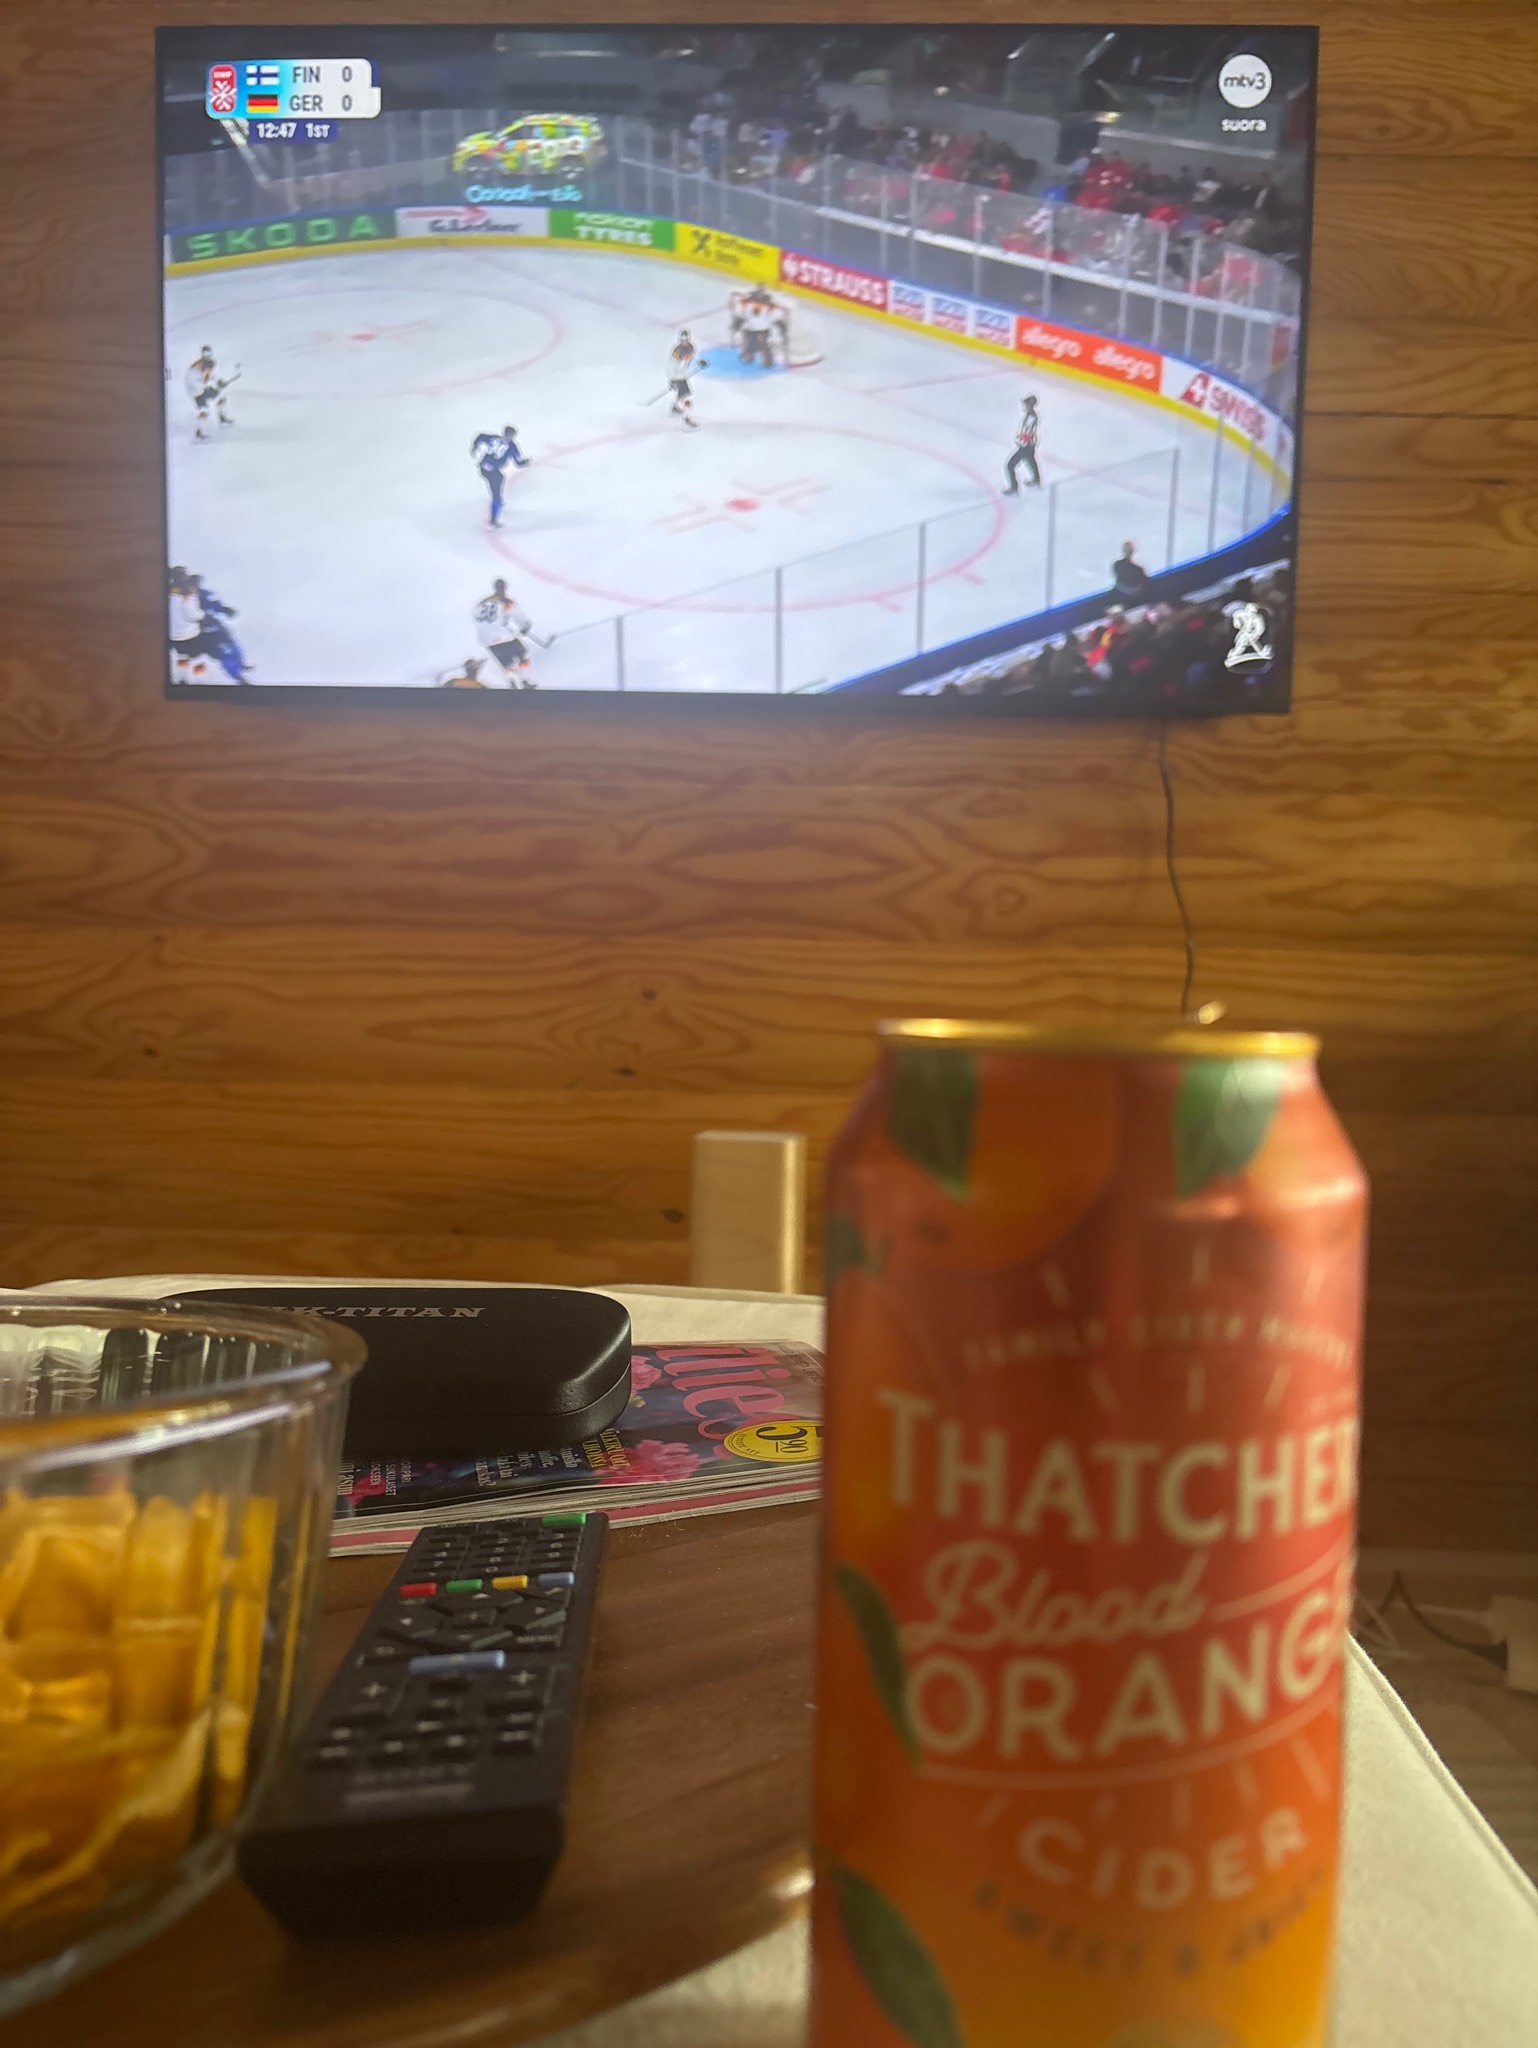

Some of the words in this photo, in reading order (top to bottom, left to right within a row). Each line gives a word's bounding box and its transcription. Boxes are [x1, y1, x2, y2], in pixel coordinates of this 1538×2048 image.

[292, 66, 321, 83] FIN
[342, 66, 353, 83] 0
[1223, 72, 1266, 90] mtv3
[289, 95, 323, 111] GER
[342, 95, 353, 111] 0
[256, 123, 296, 138] 12:47
[1222, 119, 1267, 132] suora
[798, 258, 884, 306] STRAUSS
[898, 1539, 1208, 1652] Blood
[906, 1555, 1357, 1765] ORANG
[1018, 1807, 1311, 1912] CIDER
